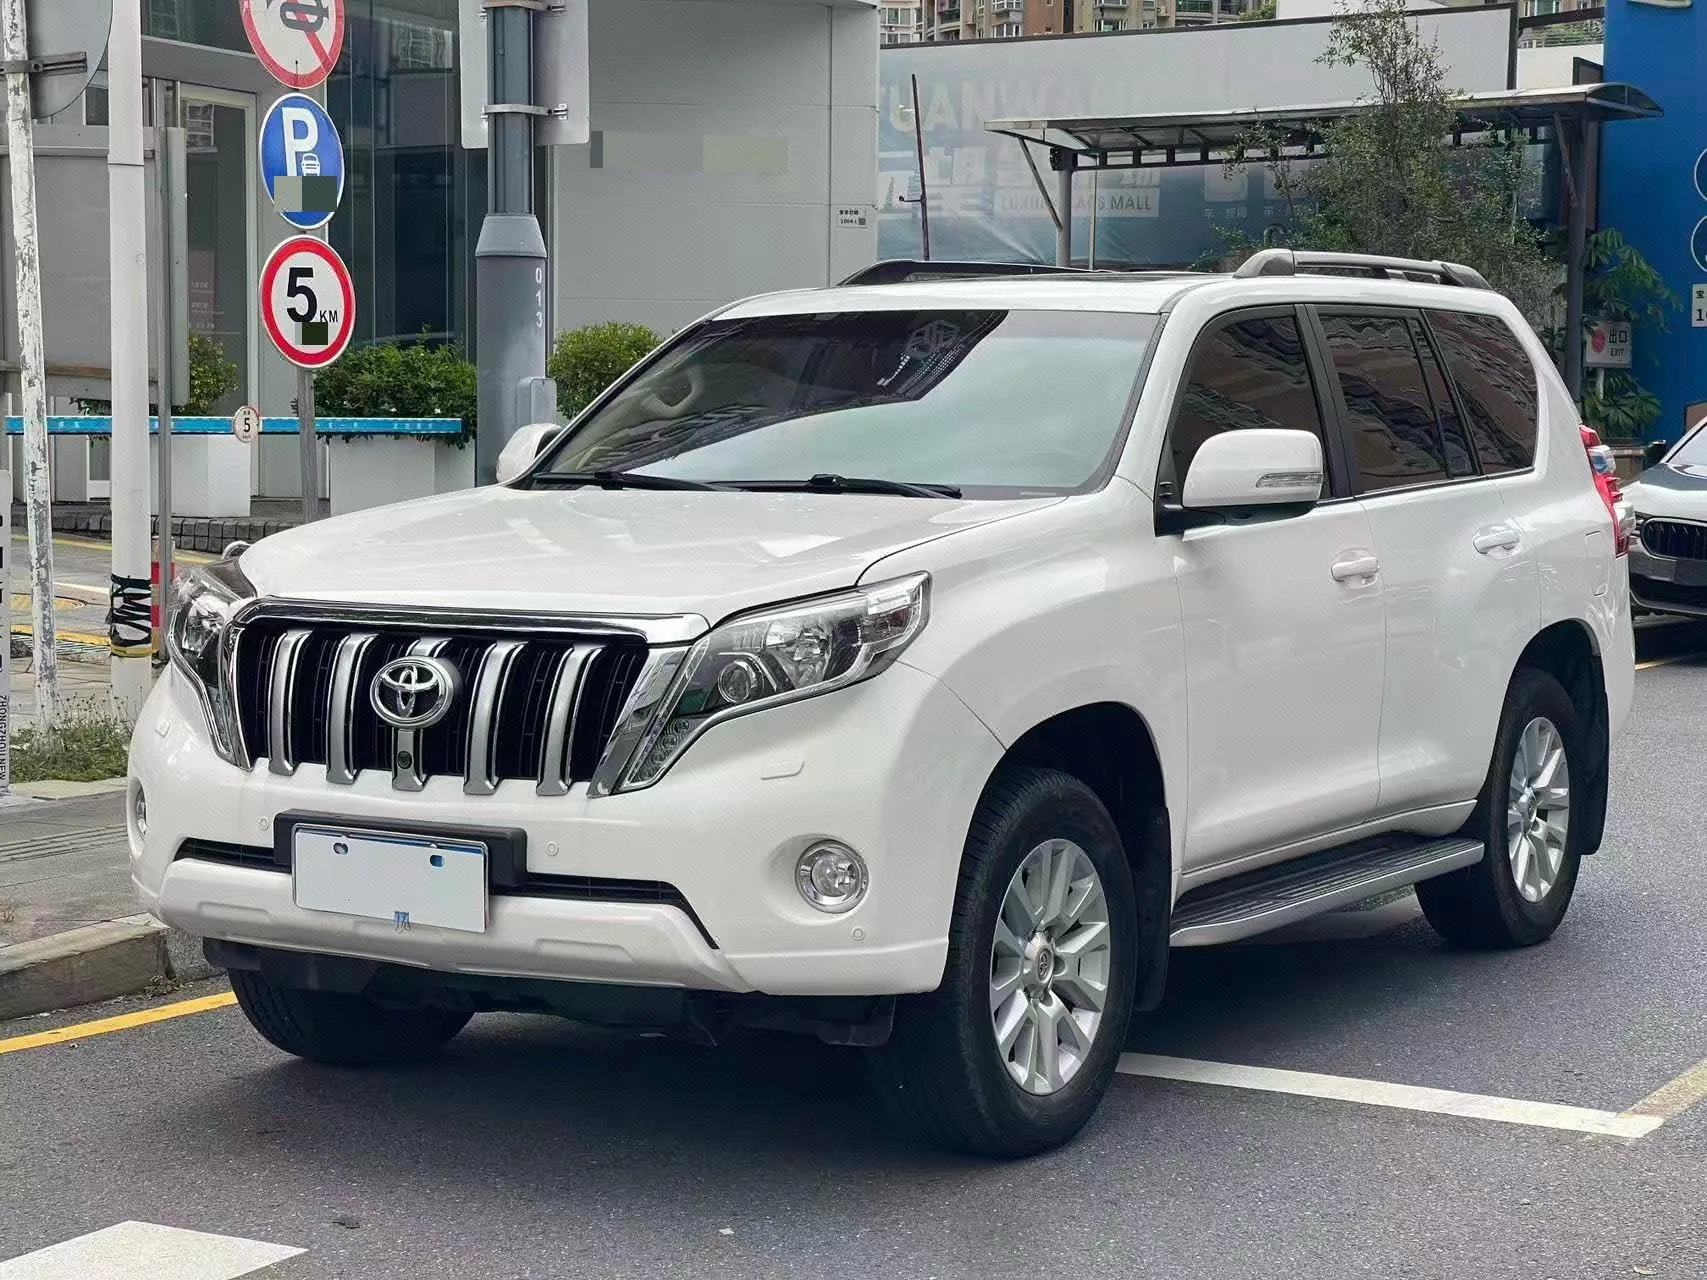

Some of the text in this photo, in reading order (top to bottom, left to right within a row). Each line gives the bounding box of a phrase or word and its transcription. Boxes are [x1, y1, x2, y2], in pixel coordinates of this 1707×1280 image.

[281, 106, 319, 177] P
[1110, 195, 1152, 211] MALL
[286, 267, 339, 324] 5 KM
[1695, 308, 1707, 322] 1
[1608, 328, 1628, 344] 出口
[1610, 348, 1625, 357] EXIT
[243, 417, 251, 433] 5
